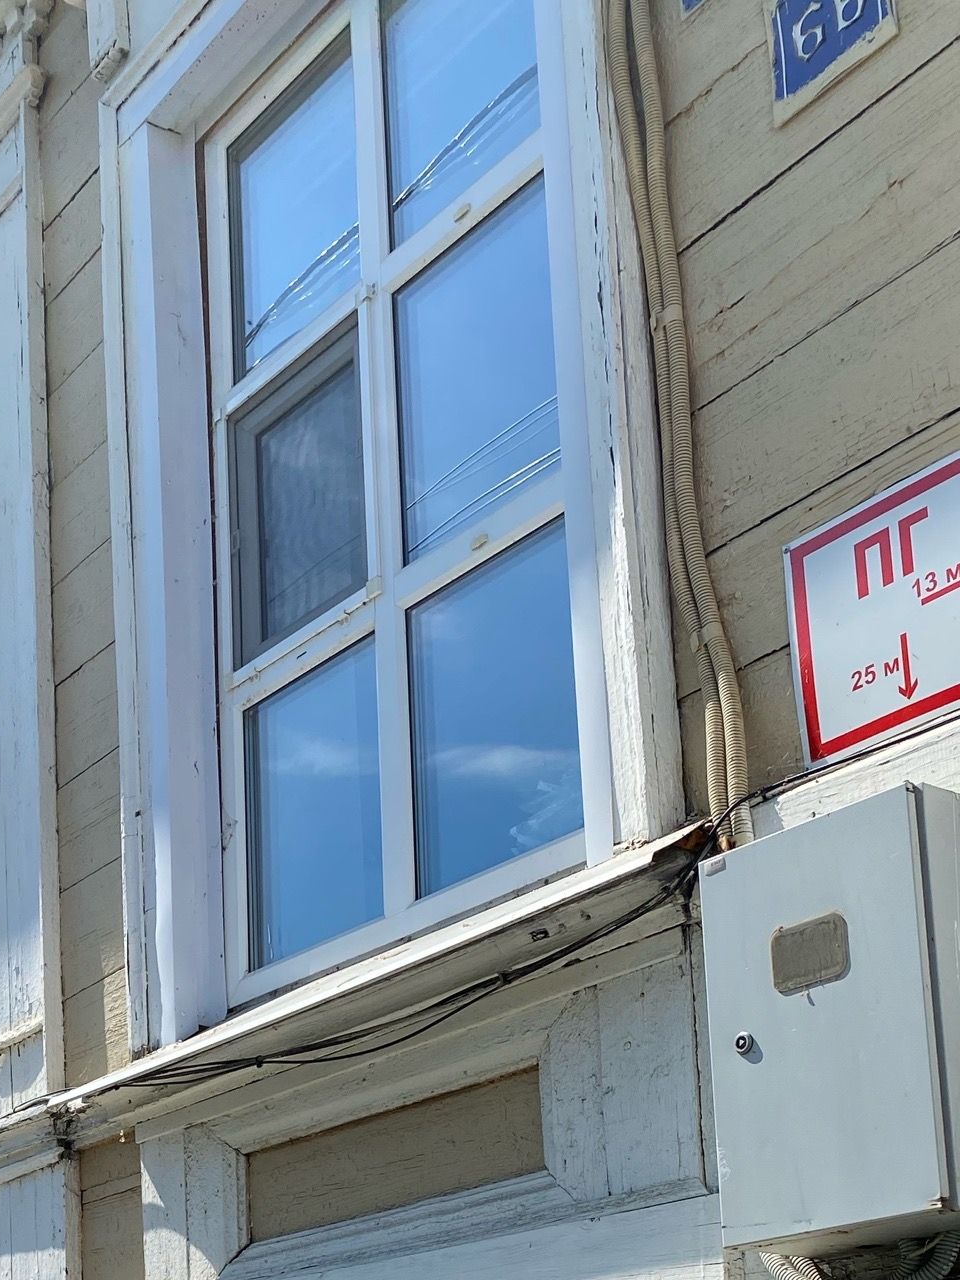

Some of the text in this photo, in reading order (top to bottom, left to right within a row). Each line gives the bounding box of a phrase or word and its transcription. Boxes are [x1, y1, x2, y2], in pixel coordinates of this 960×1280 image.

[853, 506, 929, 600] ПГ
[911, 571, 938, 598] 13
[851, 663, 876, 692] 25
